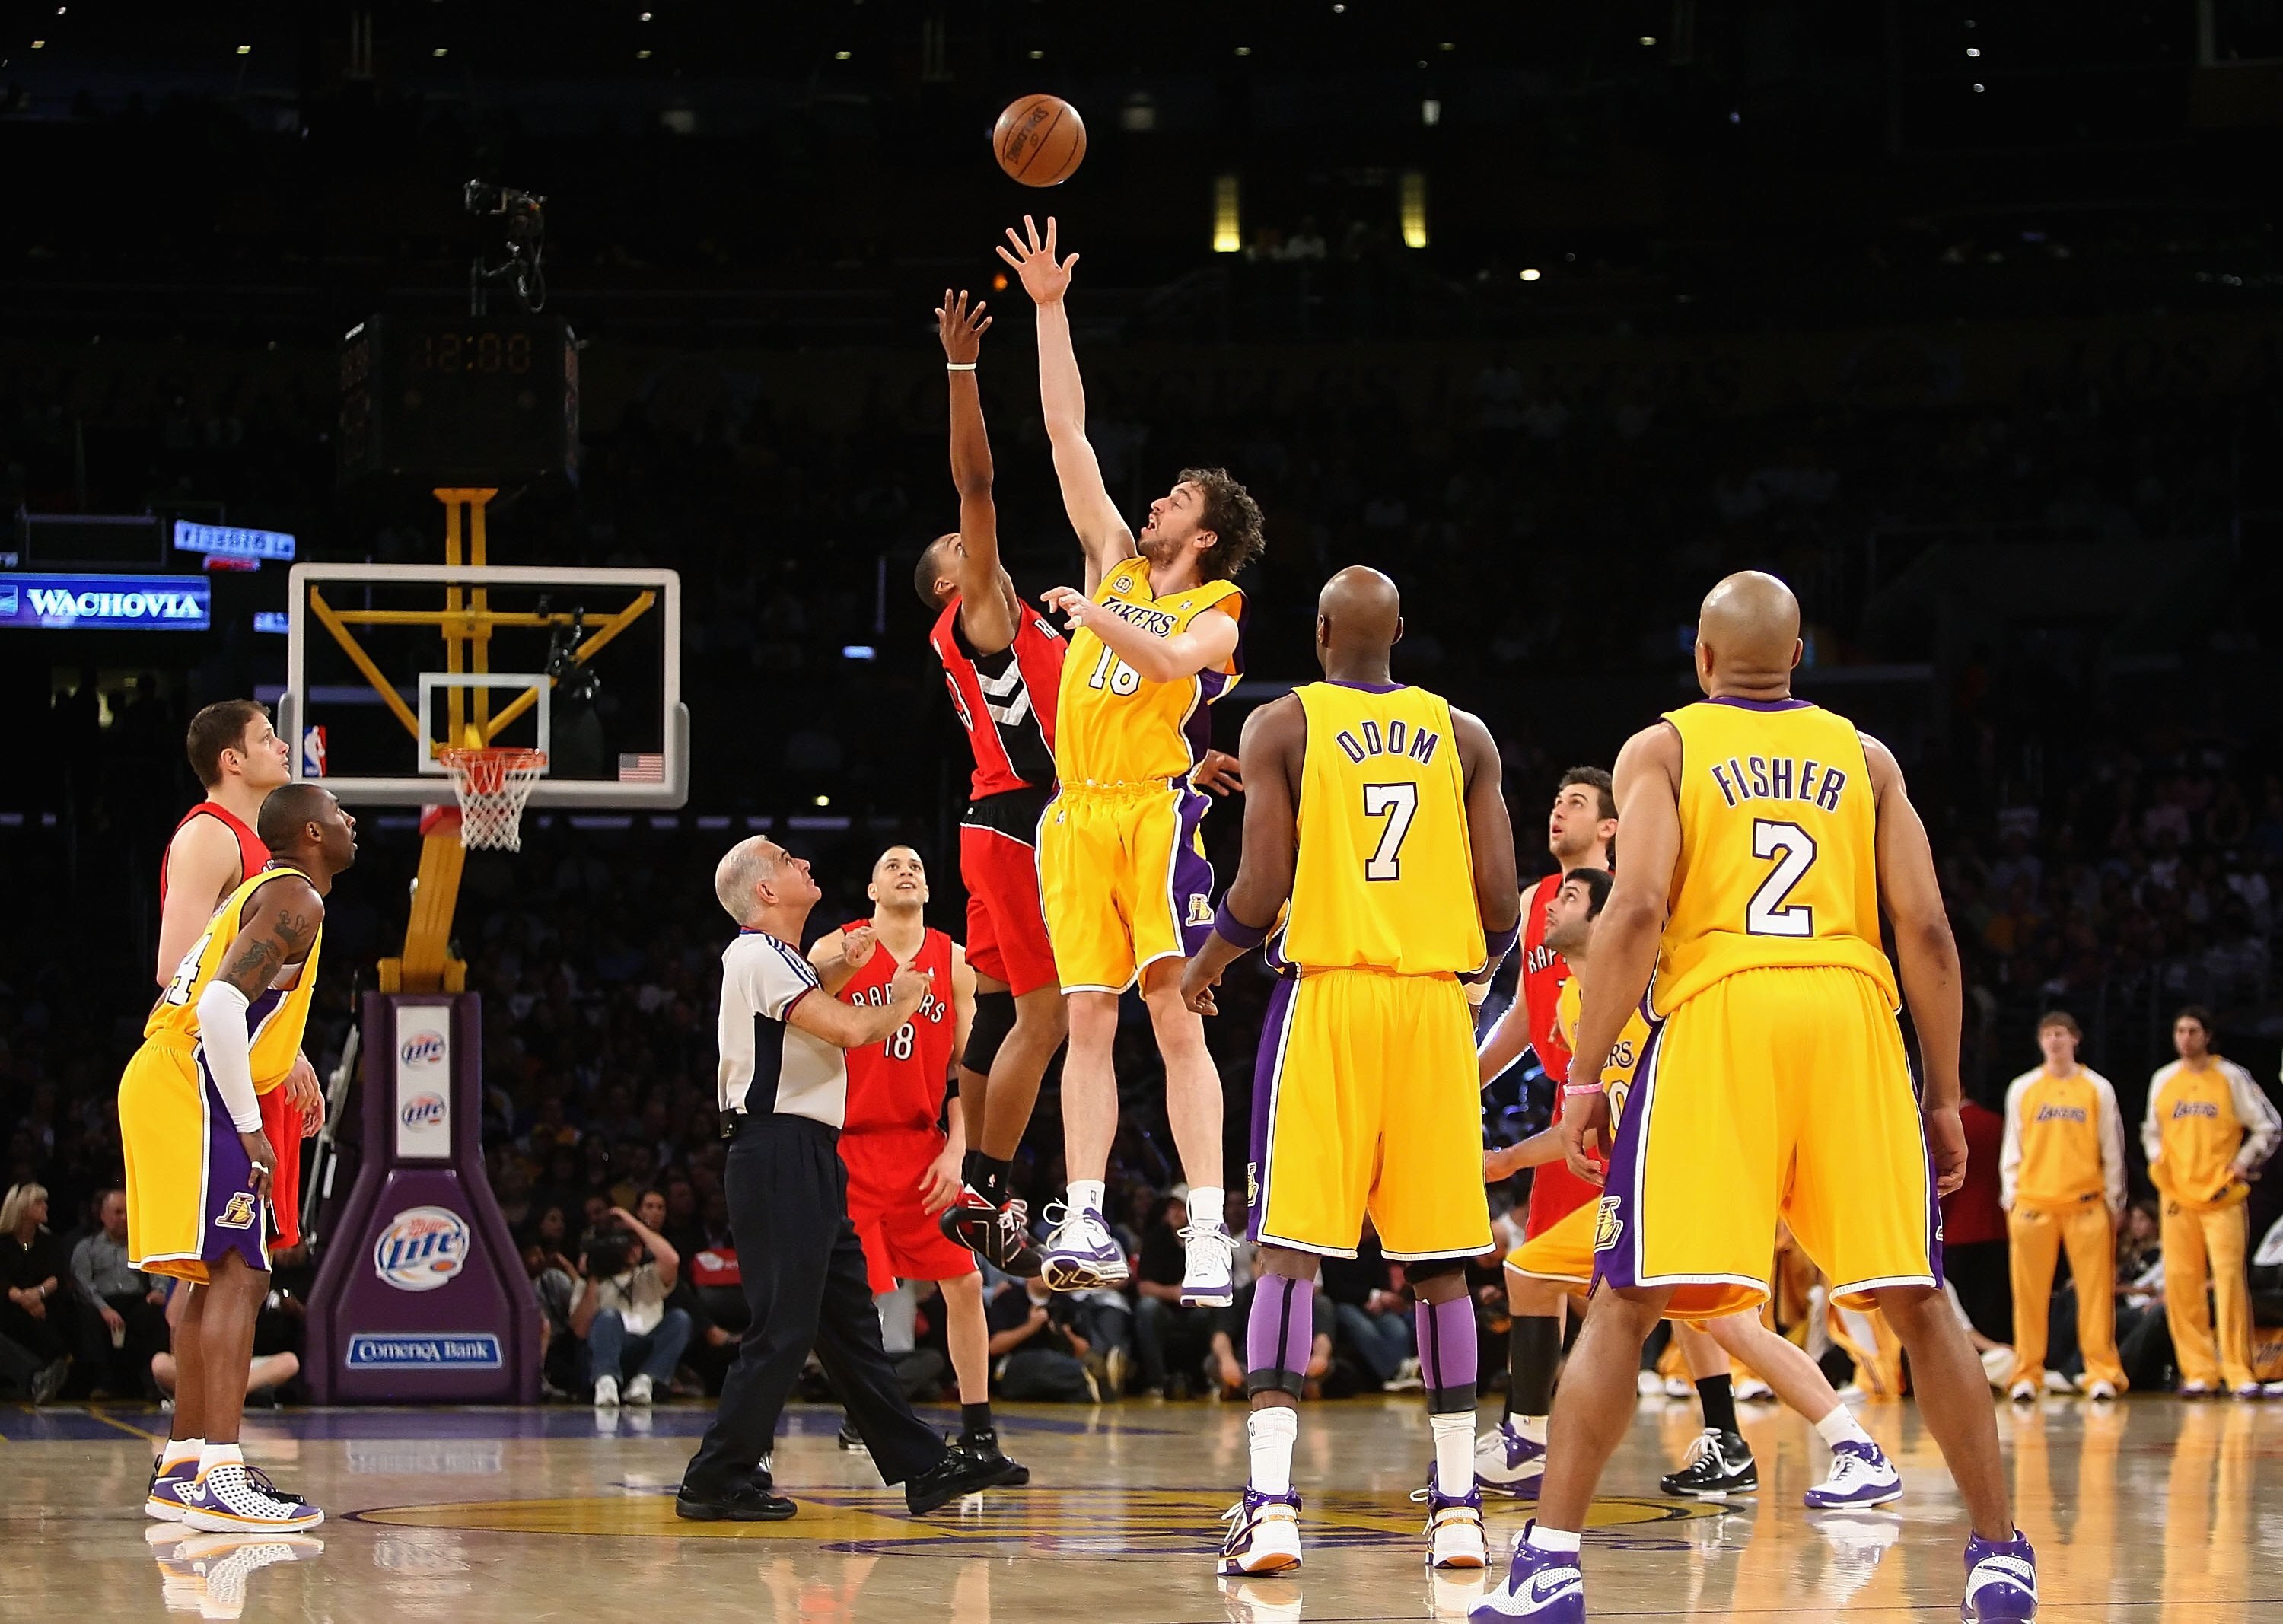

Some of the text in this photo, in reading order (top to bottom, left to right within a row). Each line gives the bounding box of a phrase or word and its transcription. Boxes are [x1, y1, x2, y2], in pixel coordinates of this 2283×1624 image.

[423, 333, 530, 374] 12:00
[27, 589, 203, 618] WACHOVIA
[1089, 644, 1141, 696] 16
[1336, 721, 1440, 764] ODOM
[1711, 756, 1846, 812] FISHER
[1363, 782, 1419, 882] 7
[1746, 817, 1817, 938] 2
[164, 932, 213, 1006] 4
[884, 1022, 914, 1060] 18
[387, 1233, 460, 1269] Lite
[444, 1342, 489, 1359] Bank
